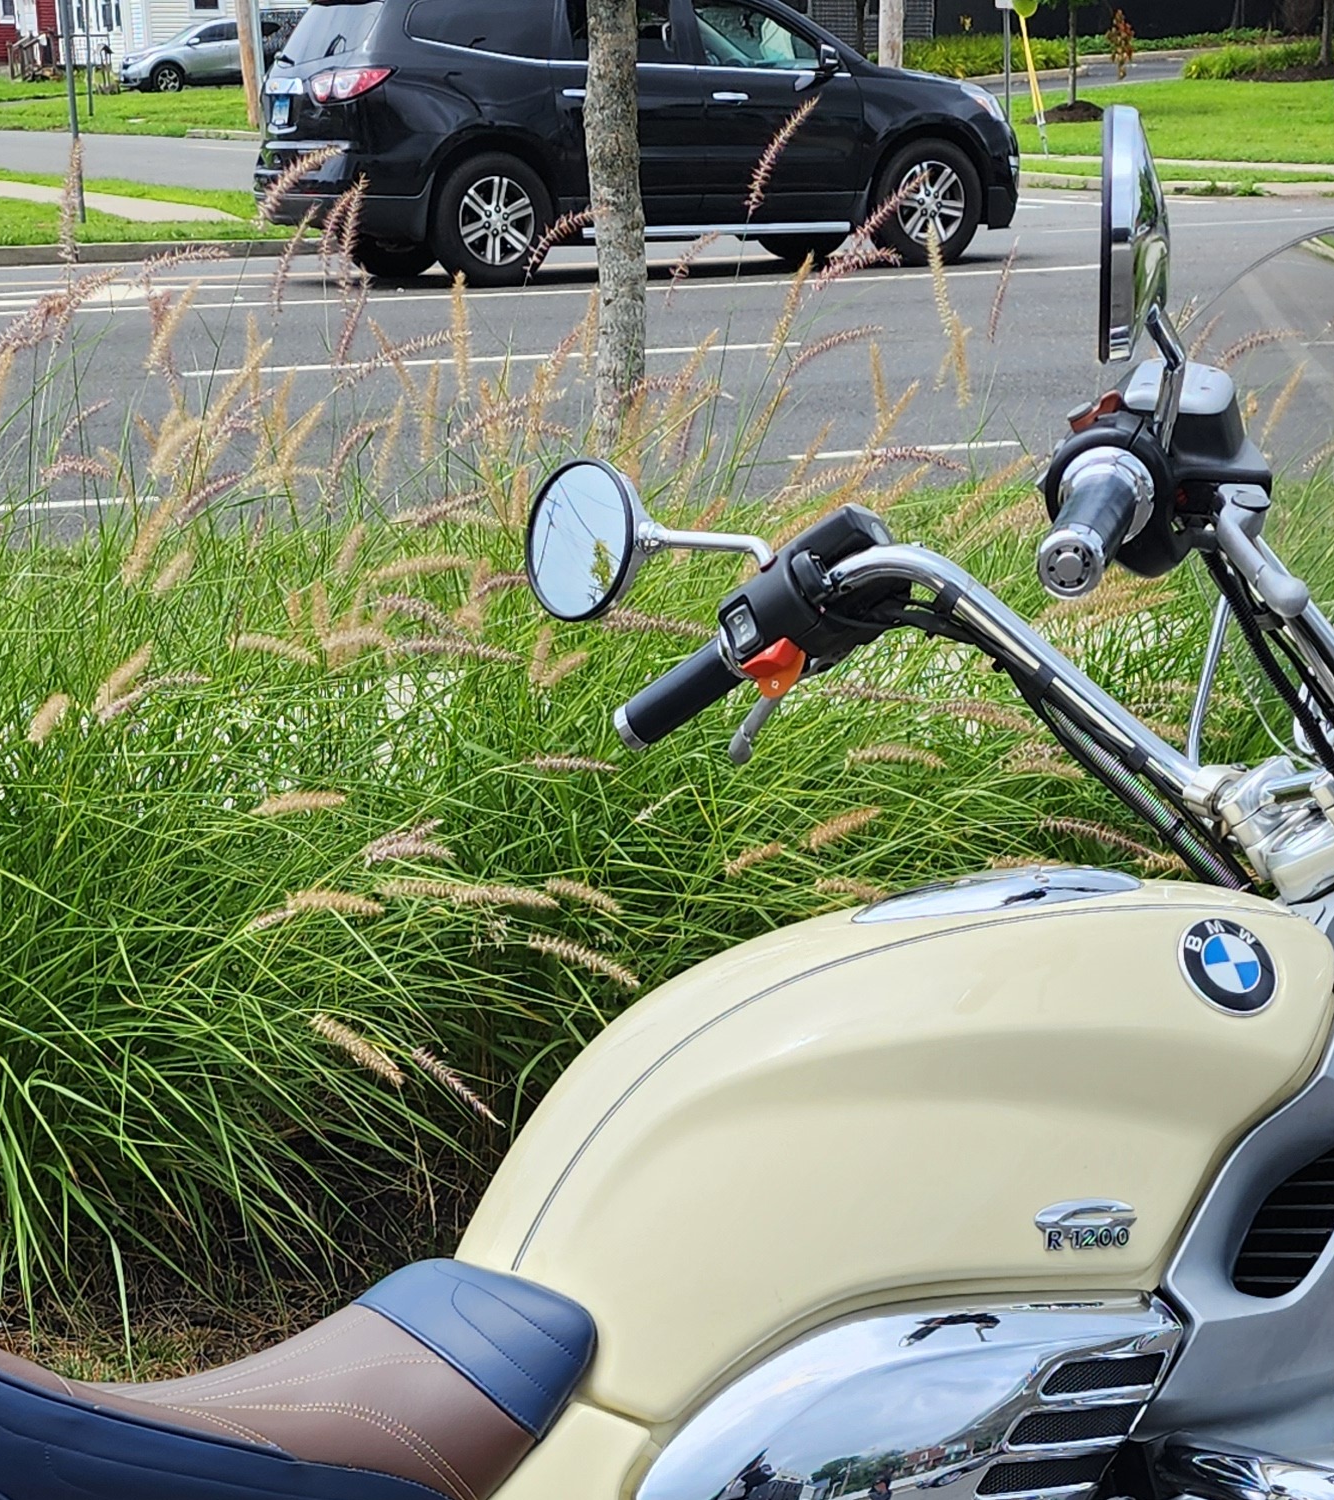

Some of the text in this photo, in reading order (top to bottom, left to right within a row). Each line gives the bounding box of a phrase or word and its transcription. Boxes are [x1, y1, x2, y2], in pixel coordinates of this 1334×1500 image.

[1185, 920, 1257, 952] BMW
[1043, 1225, 1131, 1251] R 1200
